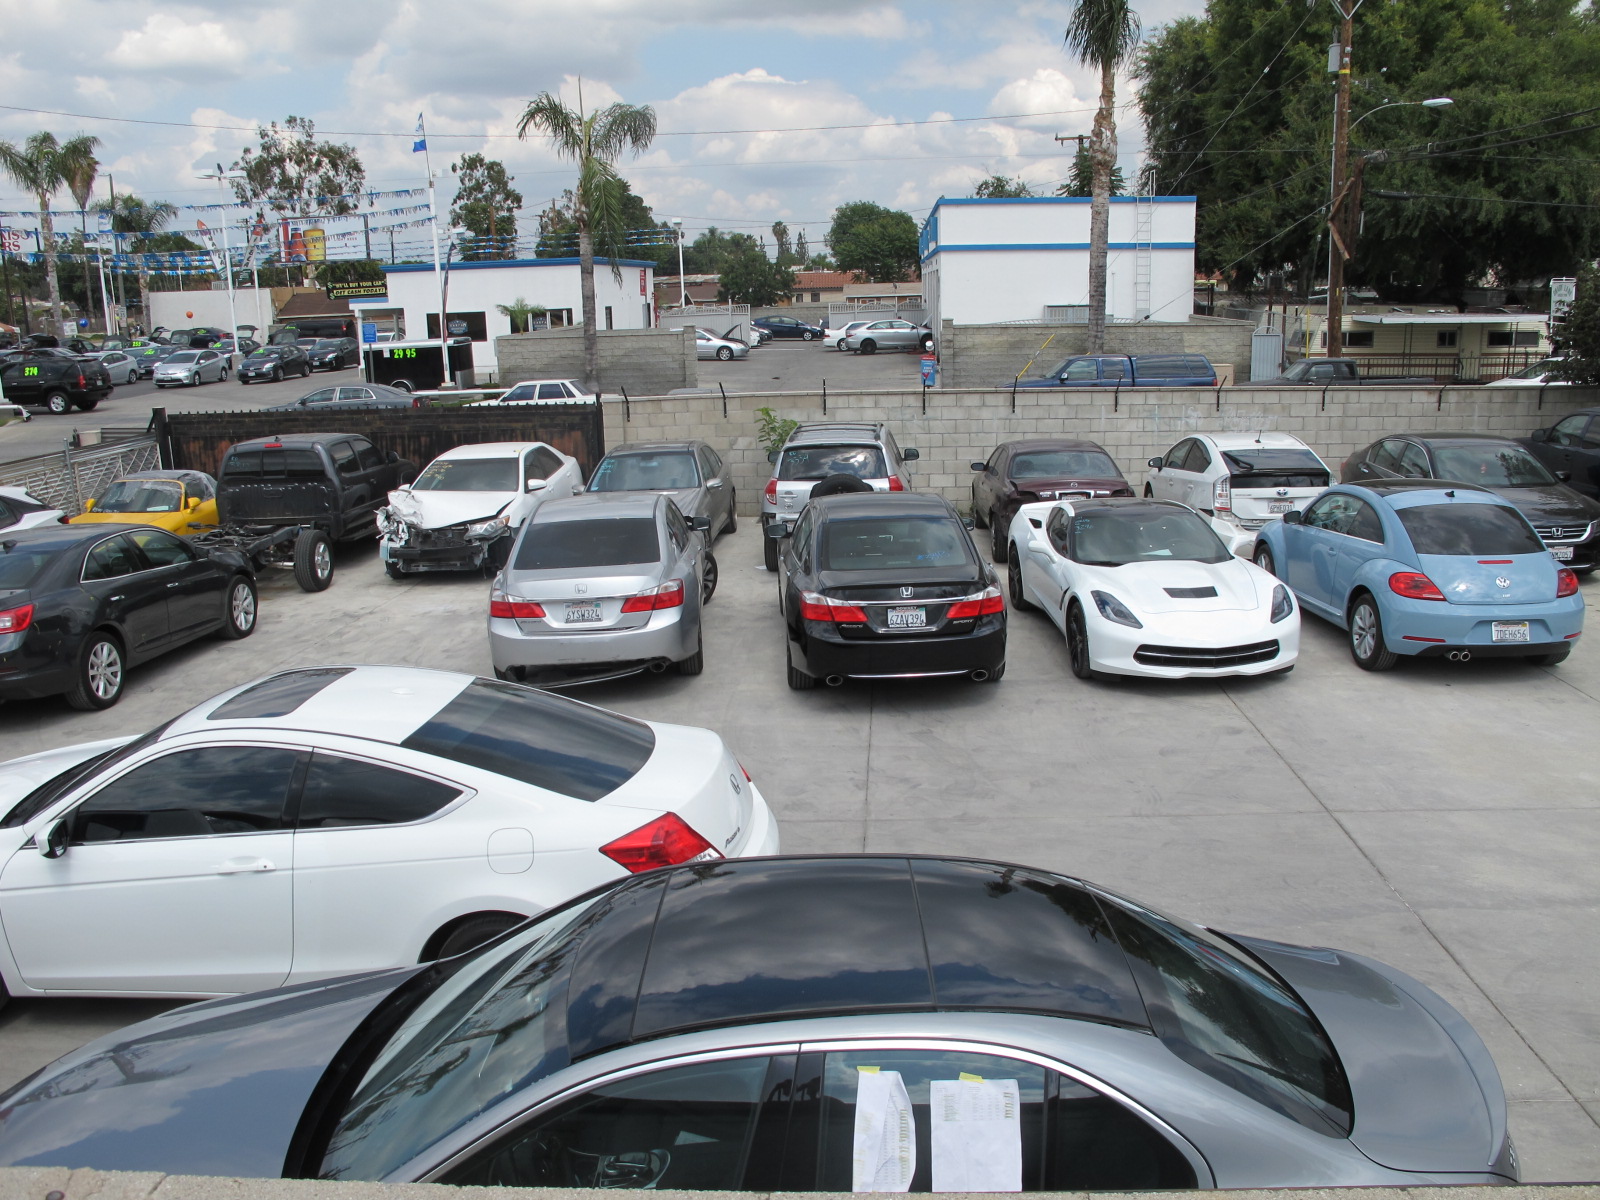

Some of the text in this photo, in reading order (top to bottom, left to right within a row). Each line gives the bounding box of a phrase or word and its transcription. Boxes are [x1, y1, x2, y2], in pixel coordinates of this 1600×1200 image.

[566, 609, 600, 619] 6YSW324
[889, 613, 924, 625] 6ZAV394
[1495, 629, 1527, 639] 7DEH656
